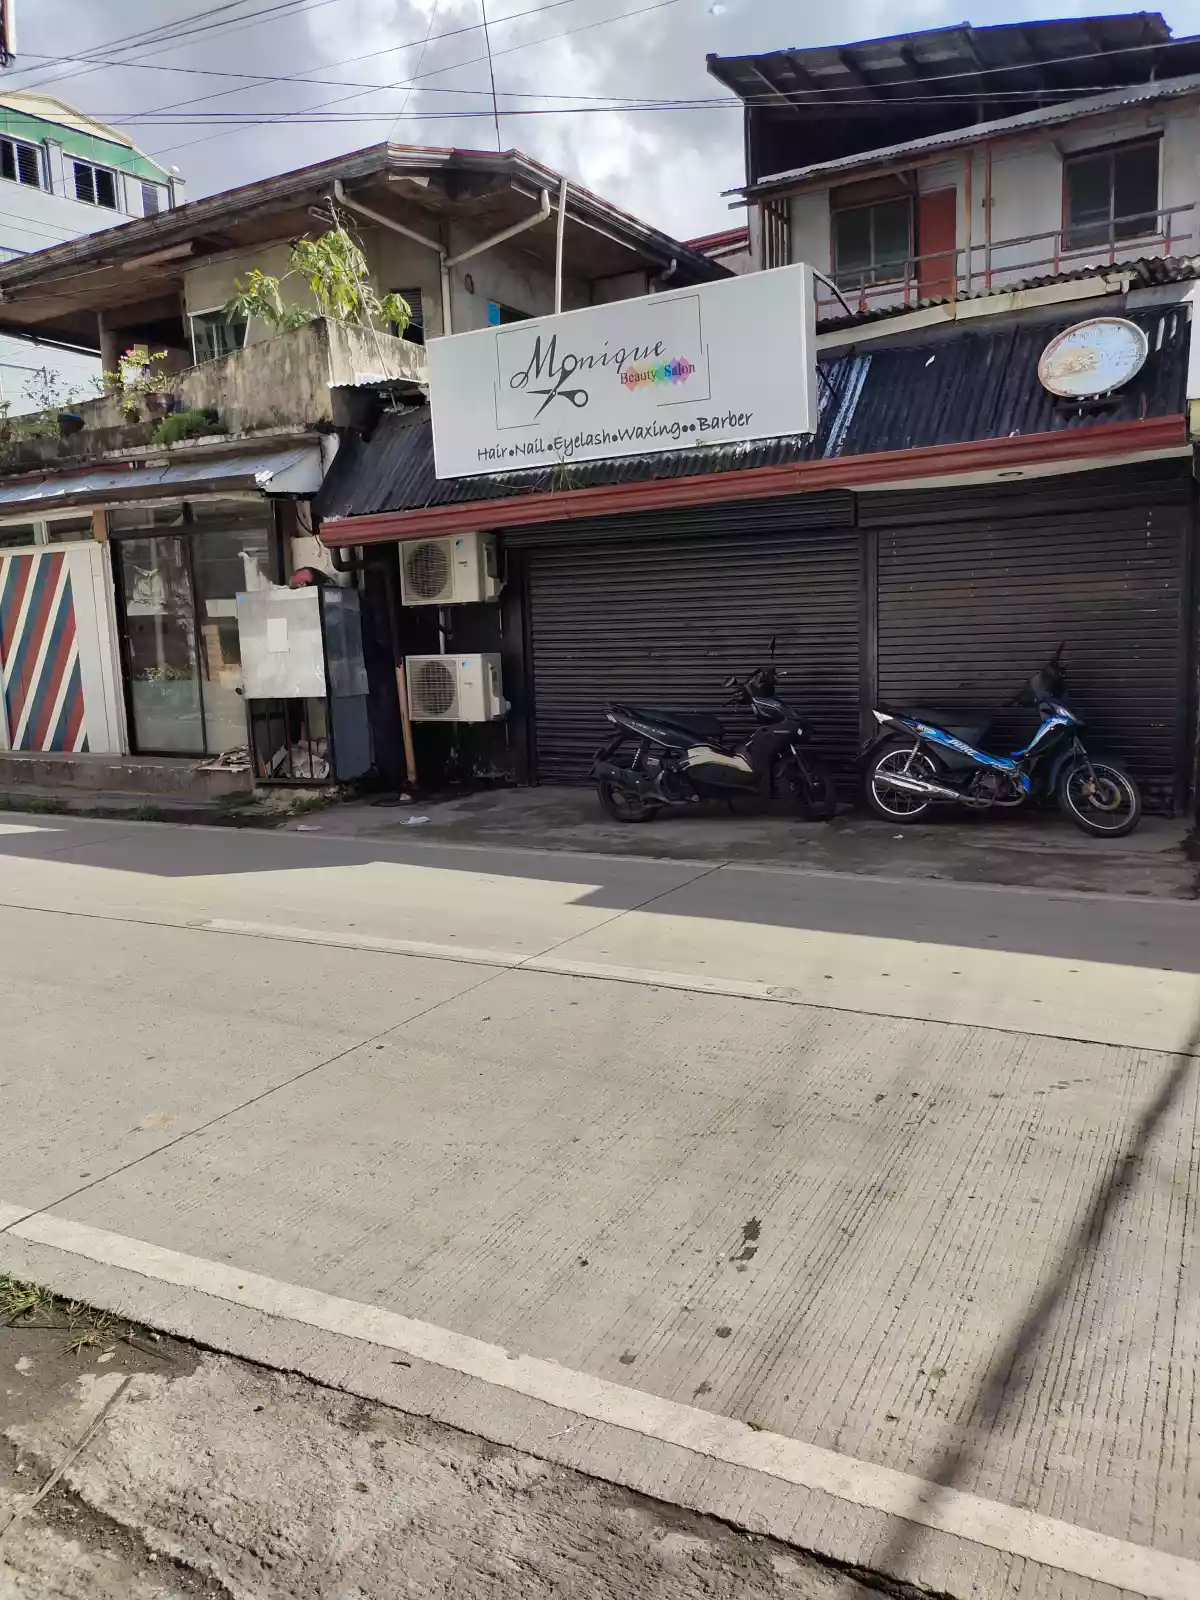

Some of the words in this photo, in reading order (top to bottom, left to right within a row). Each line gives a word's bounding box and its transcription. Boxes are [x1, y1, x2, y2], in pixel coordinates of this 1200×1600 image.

[510, 334, 667, 389] Monique
[620, 368, 657, 385] Beauty
[663, 363, 696, 378] Salon
[477, 443, 508, 461] Hair
[515, 438, 545, 456] Nail
[553, 429, 611, 457] Eyelash
[617, 420, 682, 440] Waxing
[696, 409, 753, 431] Barber
